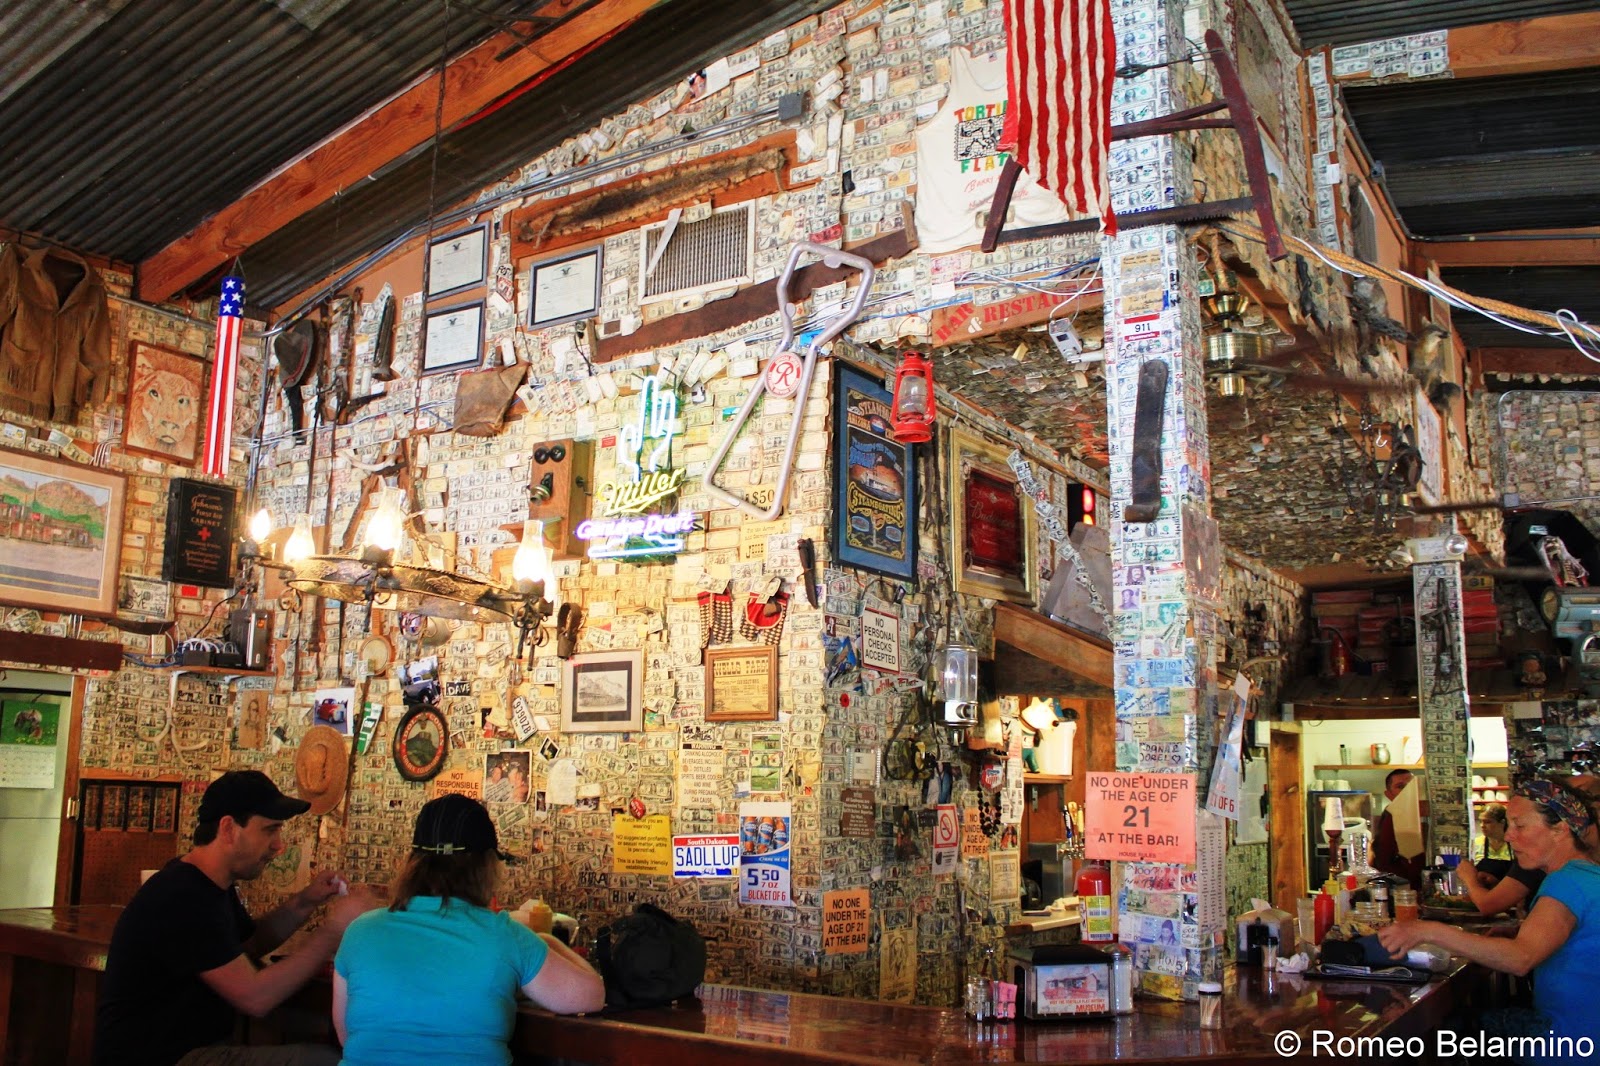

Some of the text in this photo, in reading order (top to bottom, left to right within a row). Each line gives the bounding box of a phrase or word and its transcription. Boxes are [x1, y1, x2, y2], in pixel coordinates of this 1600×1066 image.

[960, 152, 1009, 174] FLAT
[935, 301, 974, 342] BAR
[967, 316, 983, 334] &
[1134, 322, 1152, 334] 911
[597, 468, 686, 513] Miller
[191, 518, 220, 527] CABINET
[644, 511, 694, 534] Draft
[875, 618, 884, 628] NO
[864, 626, 896, 642] PERSONAL
[868, 638, 892, 653] CHECKS
[864, 649, 896, 665] ACCEPTED
[446, 682, 470, 696] DAVE
[436, 781, 479, 790] RESPONSIBLE
[1090, 776, 1188, 790] NO ONE UNDER
[1100, 790, 1178, 802] THE AGE OF
[1229, 800, 1234, 812] 6
[970, 814, 977, 822] NO
[1123, 805, 1150, 828] 21
[964, 825, 982, 833] UNDE
[966, 835, 978, 844] AGE
[1098, 832, 1179, 846] AT THE BAR!
[676, 846, 740, 866] SADLLUP
[964, 845, 972, 853] AT
[972, 846, 982, 854] THE
[747, 868, 780, 886] 5 50
[748, 890, 786, 901] BUCKET OF 6
[832, 898, 860, 909] NO ONE
[826, 909, 867, 922] UNDER THE
[828, 922, 864, 934] AGE OF 21
[824, 934, 866, 948] AT THE BAR
[1076, 1004, 1105, 1012] MUSEUM
